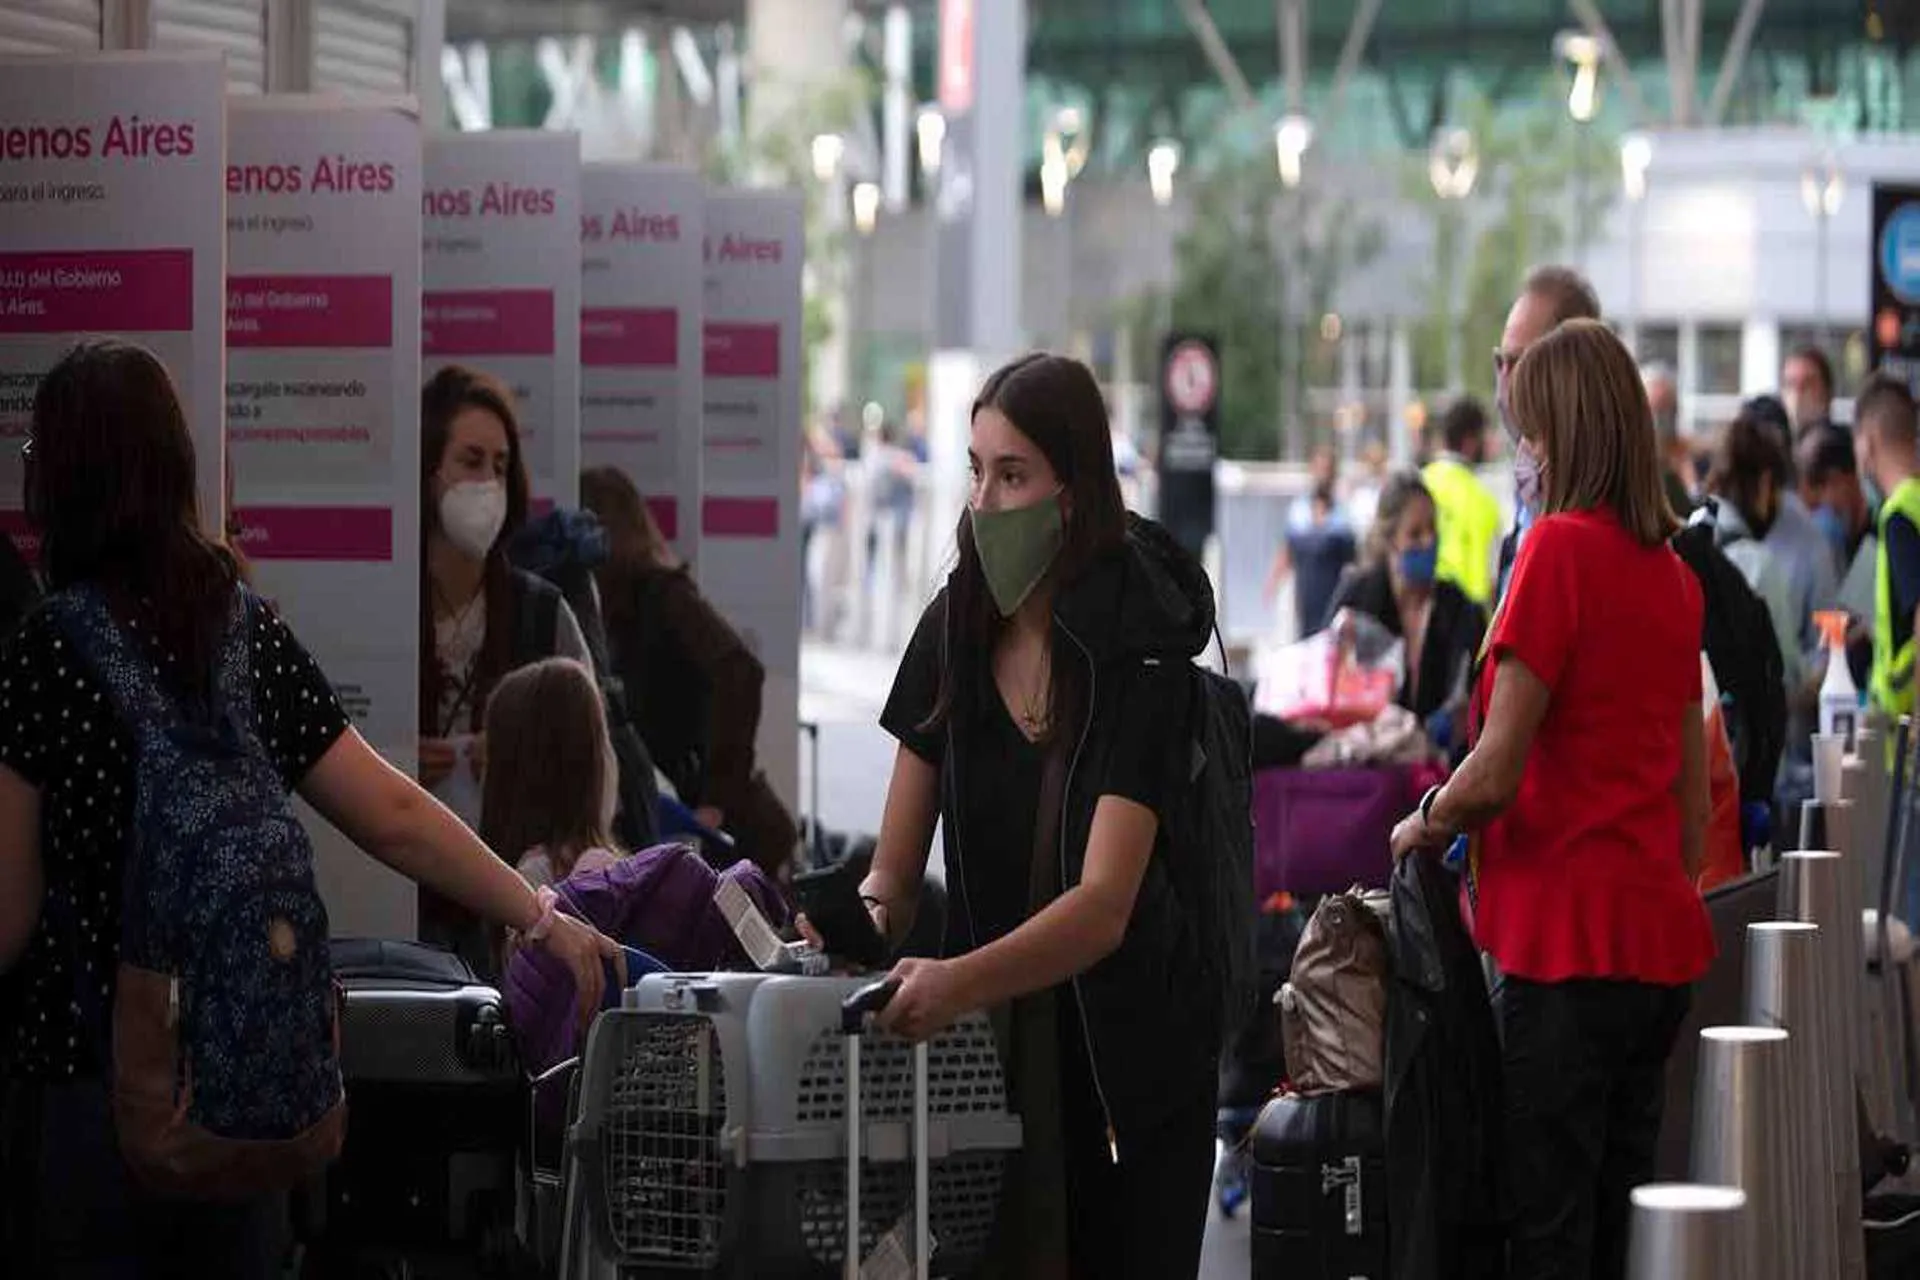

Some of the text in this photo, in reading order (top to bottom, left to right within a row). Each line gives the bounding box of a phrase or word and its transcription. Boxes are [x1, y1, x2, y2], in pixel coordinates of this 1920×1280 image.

[102, 115, 194, 159] Aires
[312, 154, 395, 195] Aires
[479, 181, 554, 216] Aires
[611, 206, 681, 242] Aires
[719, 231, 783, 265] Aires
[54, 266, 122, 288] Gobierno
[267, 291, 329, 310] Gobierno
